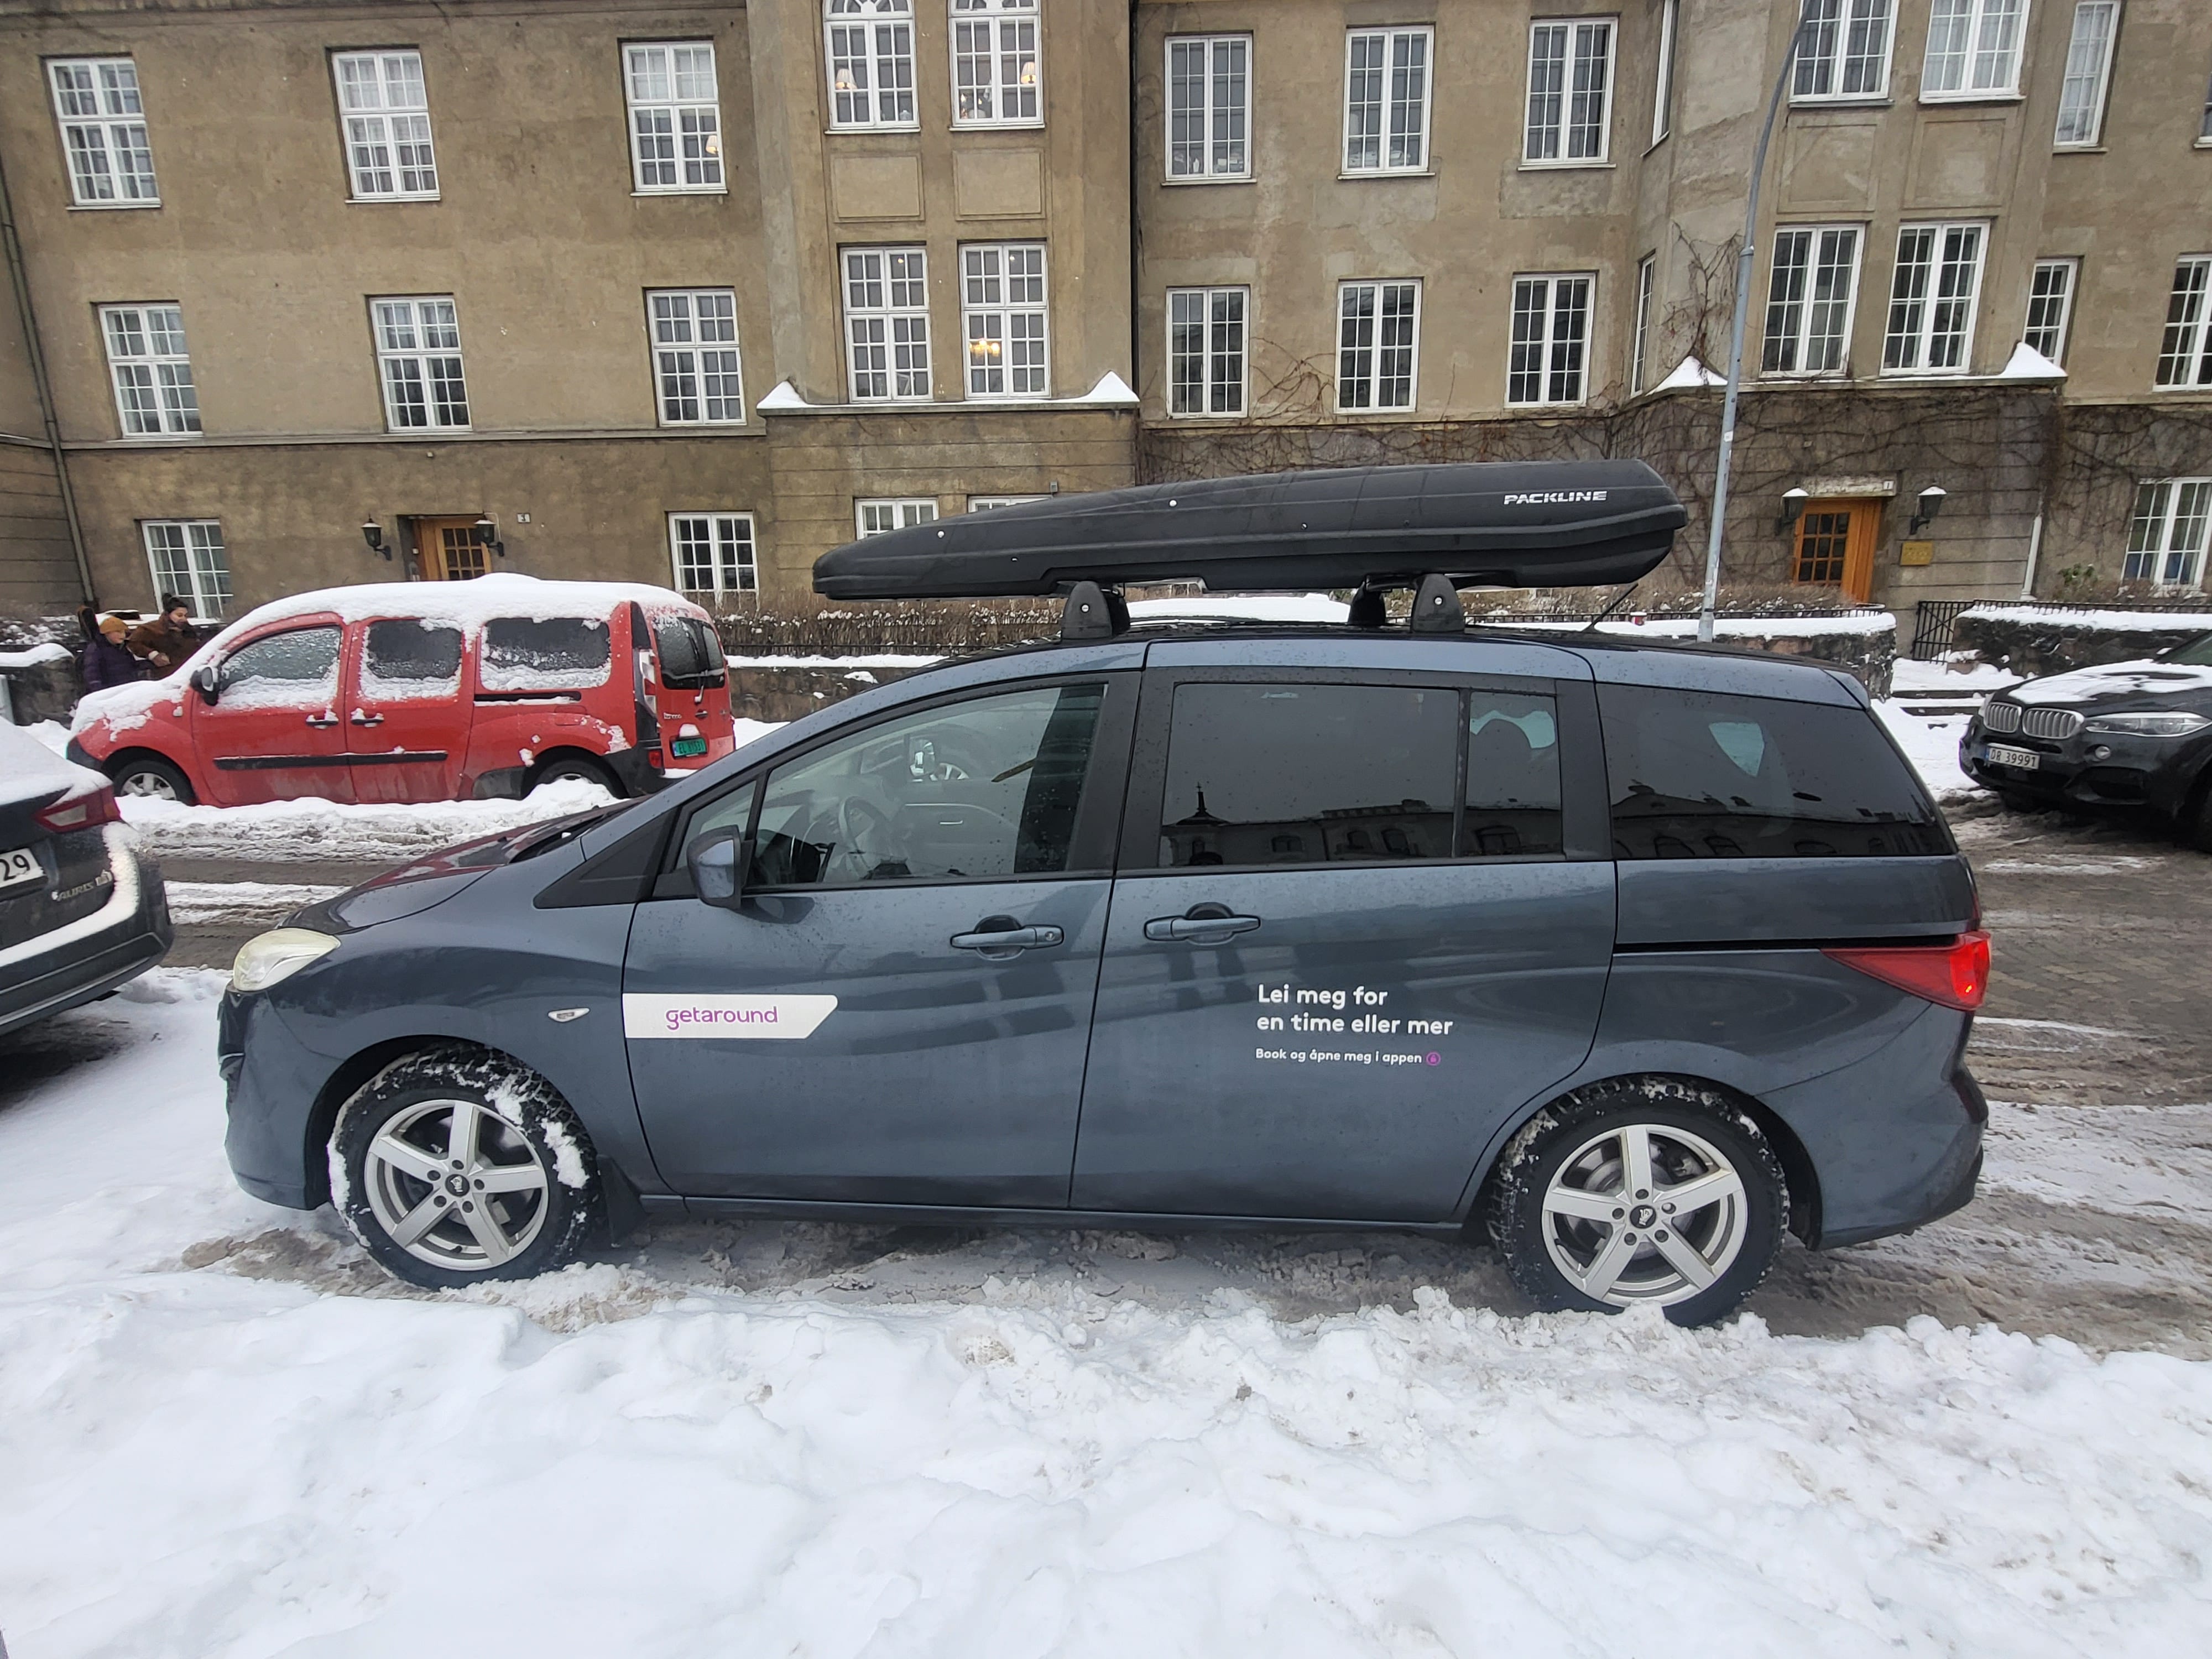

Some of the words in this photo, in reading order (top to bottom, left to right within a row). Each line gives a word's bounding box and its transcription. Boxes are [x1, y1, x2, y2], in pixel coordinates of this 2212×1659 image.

[1504, 491, 1608, 505] PACKLINE
[2005, 752, 2036, 767] 39991
[1258, 984, 1289, 1003] Lei
[1297, 989, 1346, 1010] meg
[1353, 985, 1388, 1005] for
[666, 1006, 778, 1030] getaround
[1257, 1016, 1284, 1031] en
[1290, 1012, 1345, 1032] time
[1351, 1014, 1401, 1034] eller
[1408, 1020, 1453, 1035] mer
[1255, 1048, 1287, 1059] Book
[1290, 1051, 1306, 1063] og
[1309, 1048, 1341, 1063] åpne
[1344, 1053, 1371, 1065] meg
[1375, 1051, 1379, 1062] i
[1382, 1054, 1422, 1066] appen
